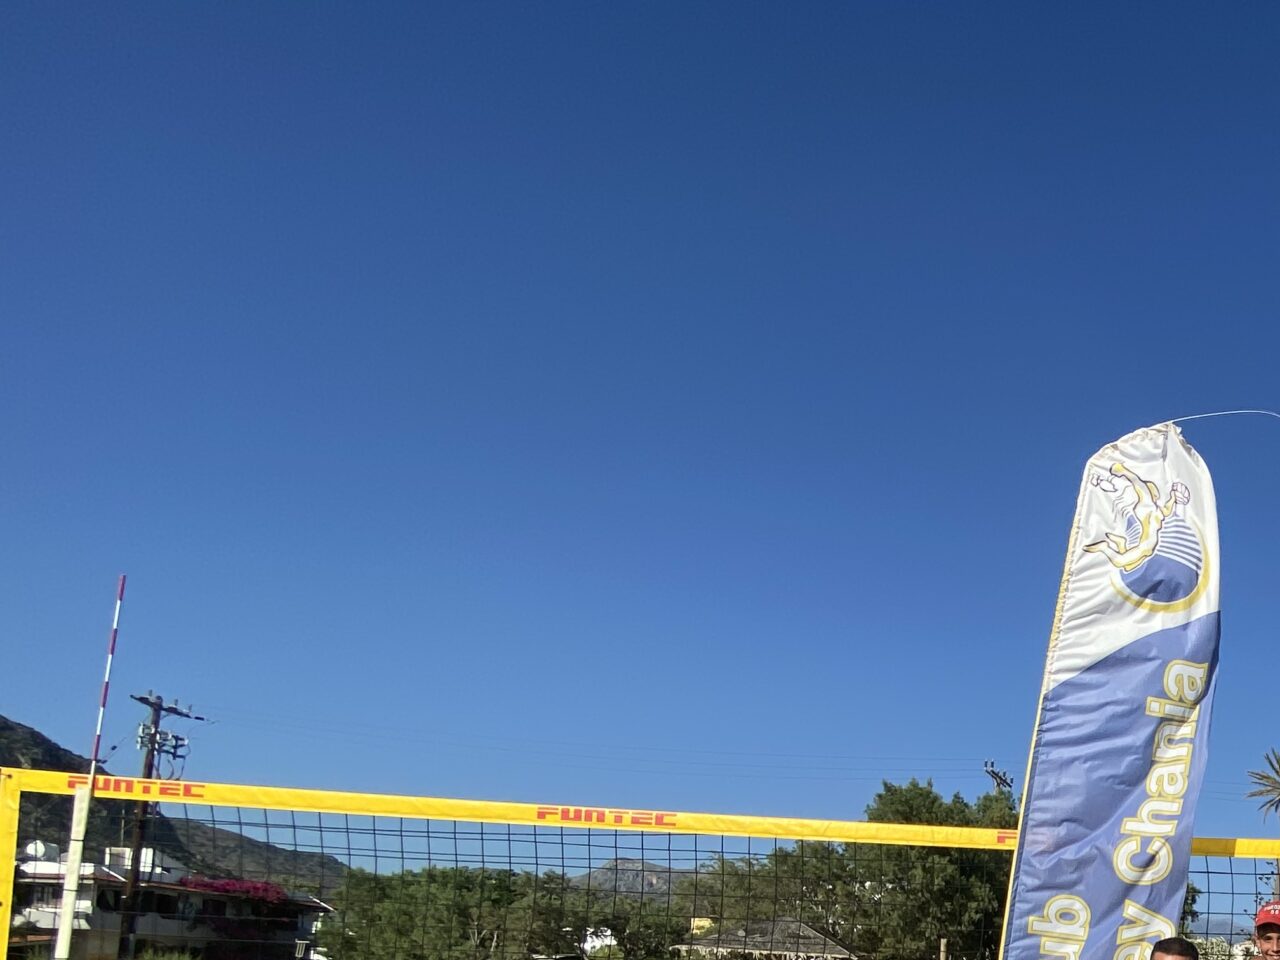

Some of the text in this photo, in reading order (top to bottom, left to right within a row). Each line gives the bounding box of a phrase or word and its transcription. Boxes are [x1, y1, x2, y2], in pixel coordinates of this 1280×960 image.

[1112, 659, 1208, 886] Chania
[67, 775, 206, 798] FUNTEC
[537, 807, 677, 827] FUNTEC
